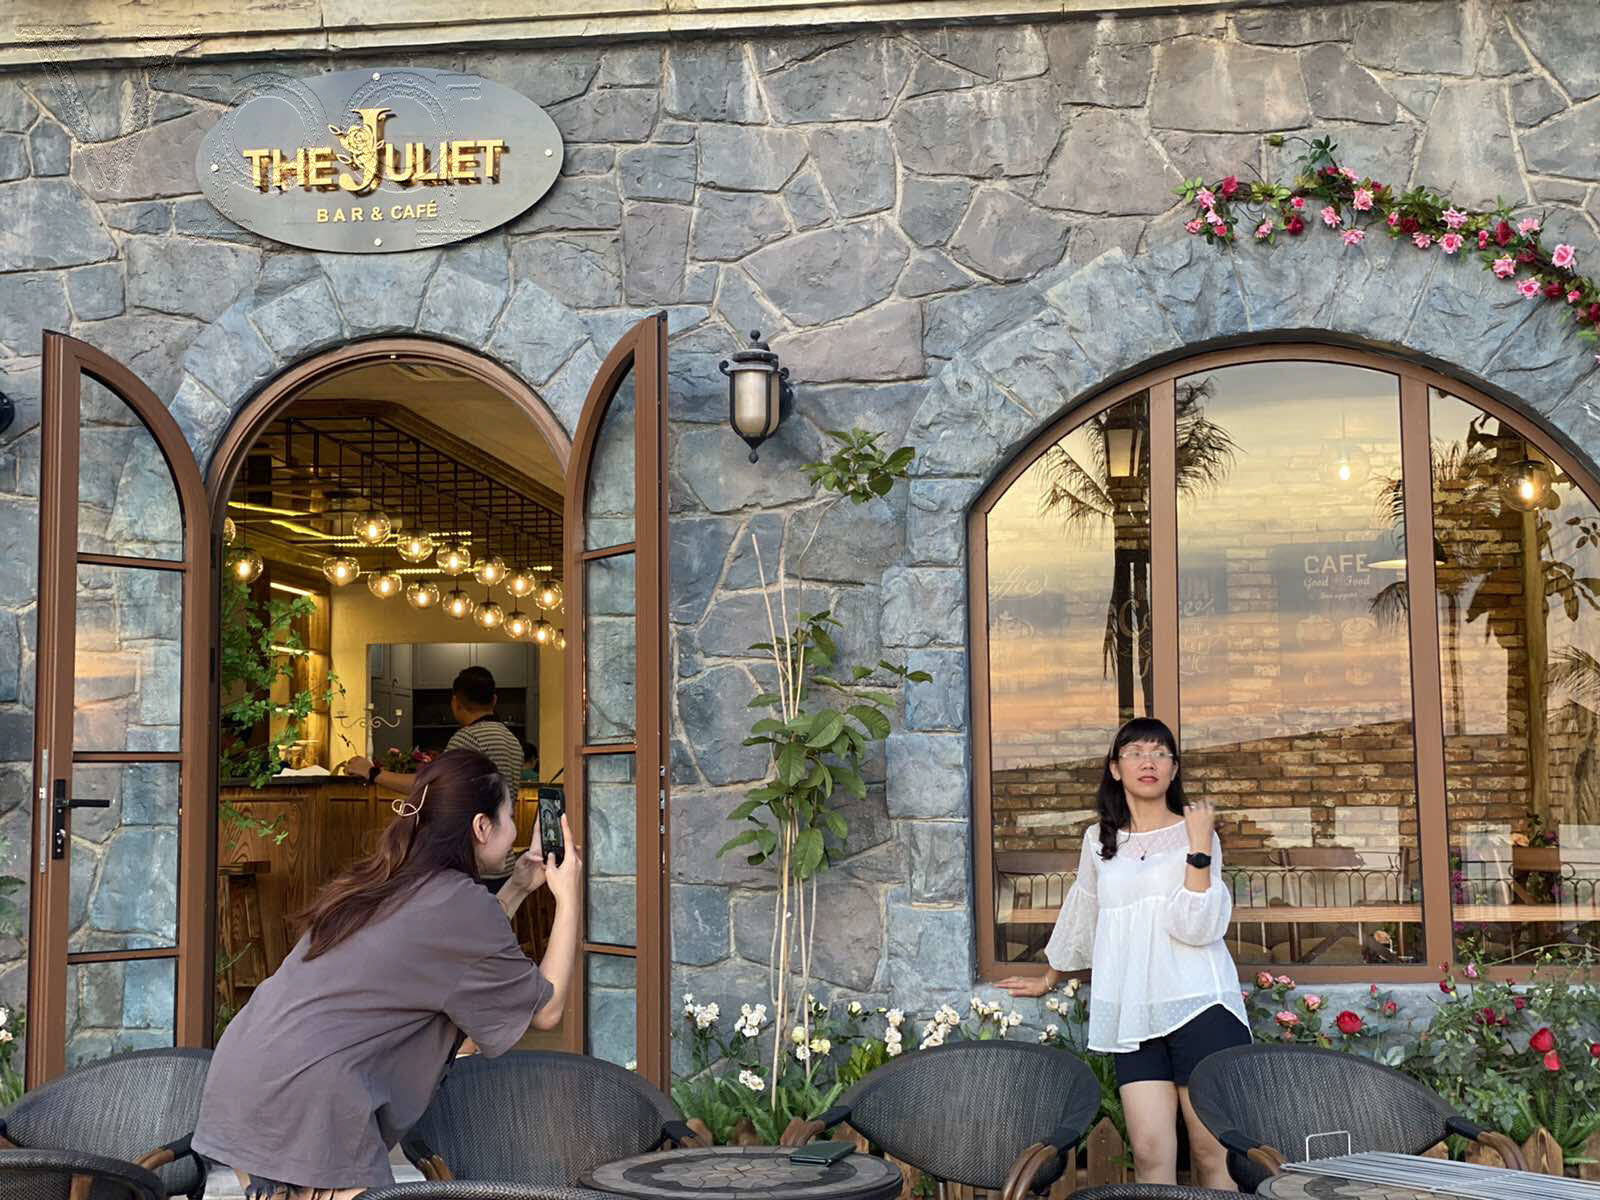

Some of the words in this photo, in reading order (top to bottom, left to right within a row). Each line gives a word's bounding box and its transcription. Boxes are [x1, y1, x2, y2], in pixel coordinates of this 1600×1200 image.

[243, 147, 335, 188] THE
[339, 108, 504, 192] JULIET
[316, 207, 364, 223] BAR
[370, 206, 384, 222] &
[390, 200, 438, 221] CAFÉ
[1303, 553, 1370, 574] CAFE
[1303, 575, 1328, 592] Good
[1343, 574, 1371, 586] Food
